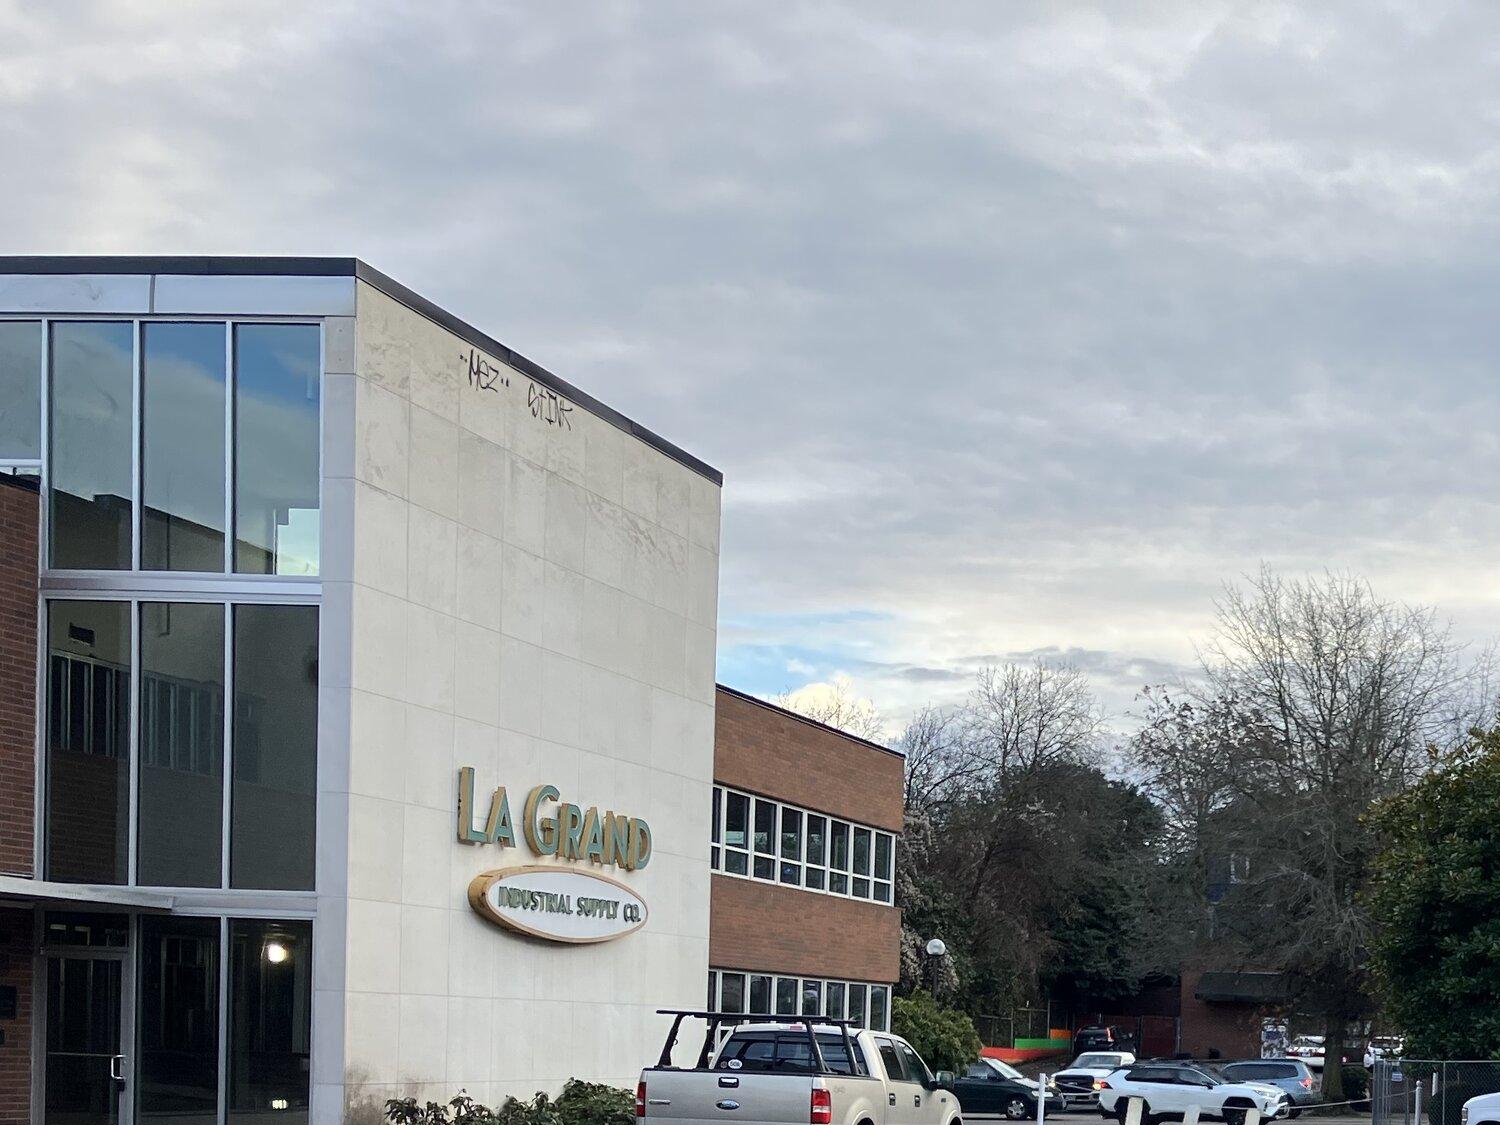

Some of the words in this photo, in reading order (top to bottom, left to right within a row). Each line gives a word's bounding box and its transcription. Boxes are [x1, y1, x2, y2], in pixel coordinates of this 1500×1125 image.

[457, 767, 516, 848] LA
[523, 784, 652, 871] GRAND
[498, 886, 573, 914] INDUSTRIAL
[577, 896, 619, 919] SUPPLY
[623, 903, 642, 922] CO.
